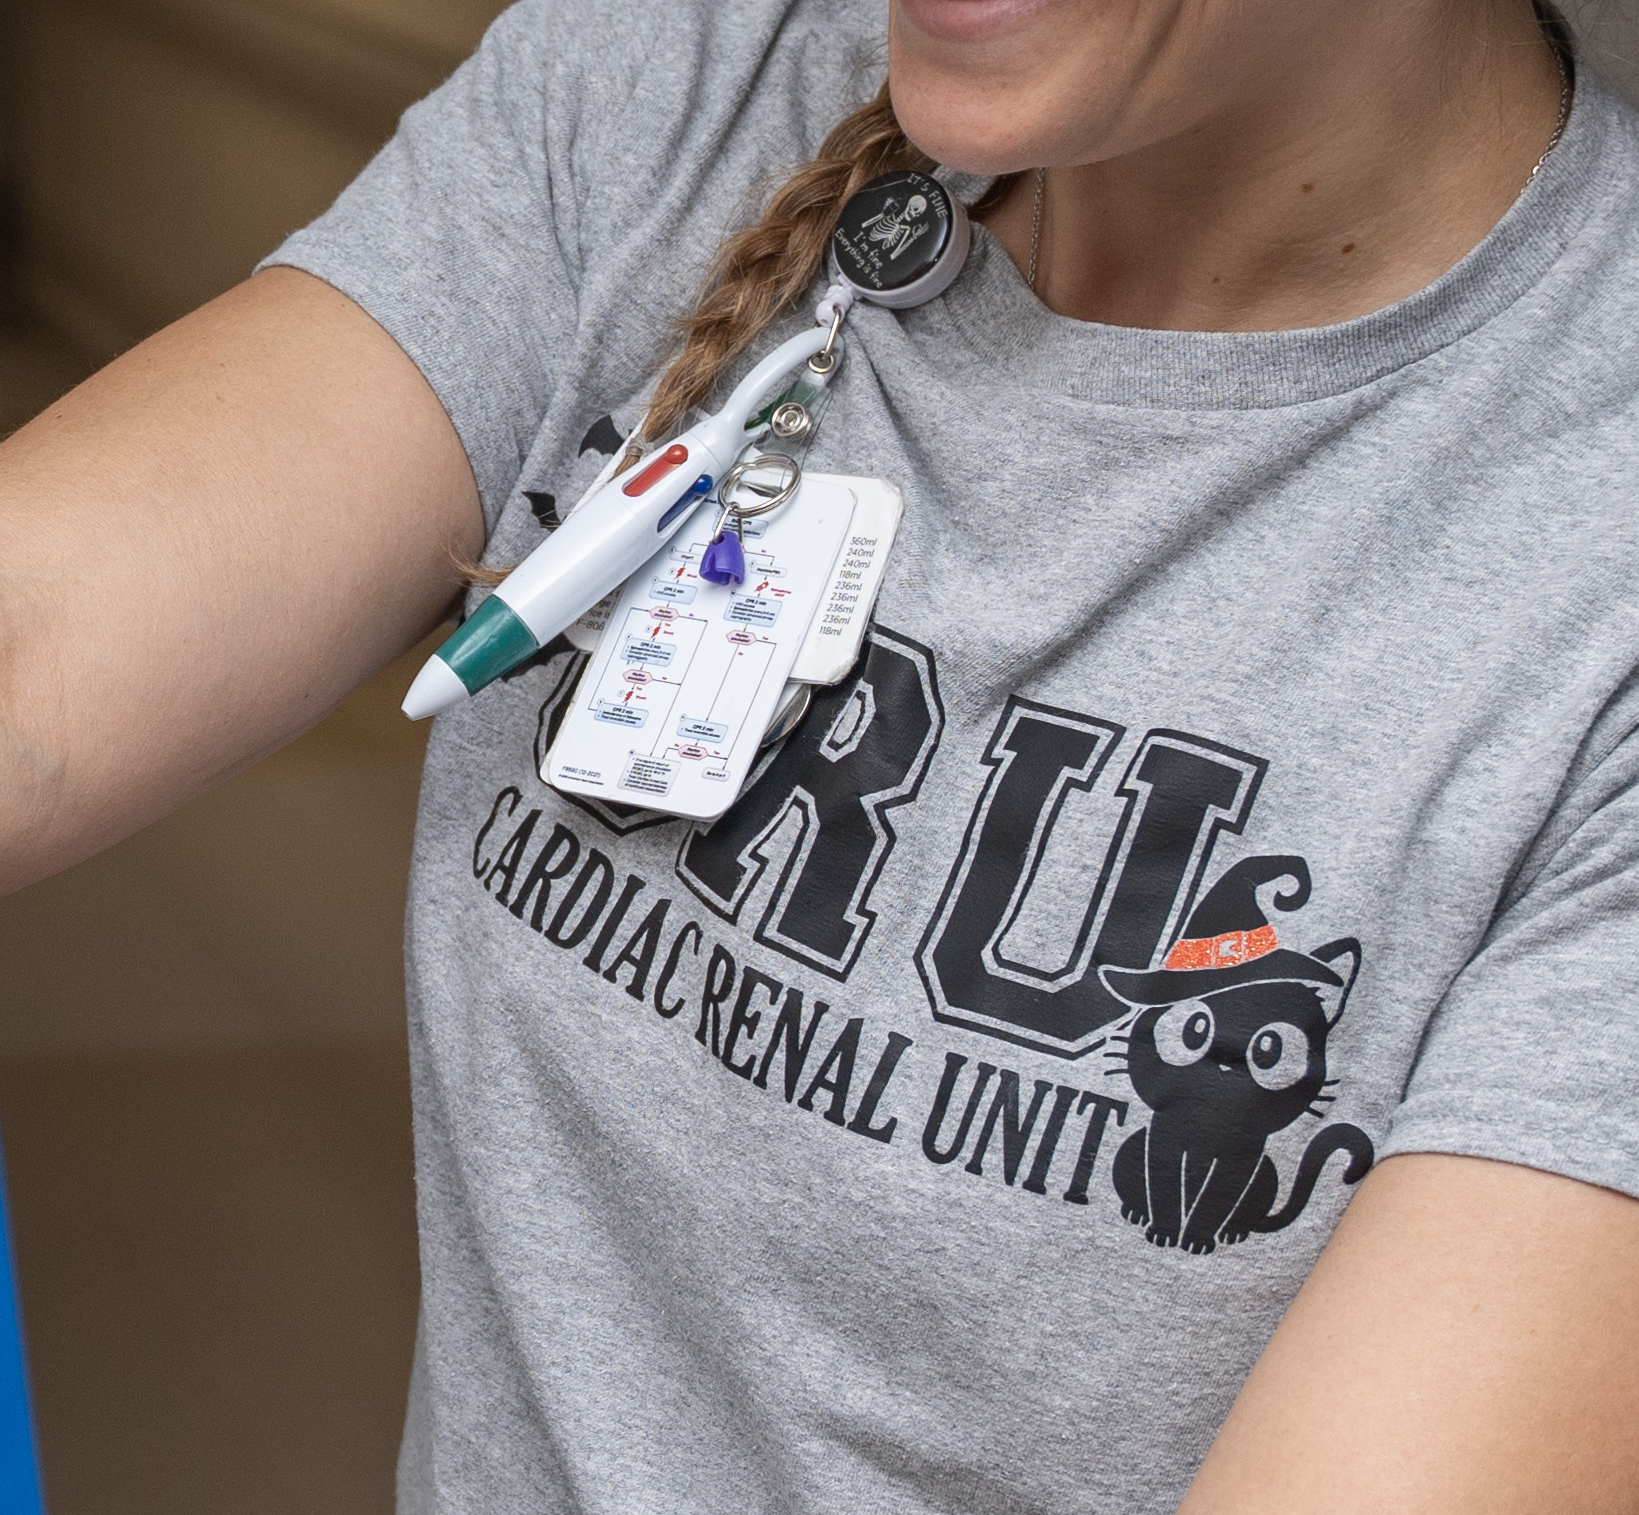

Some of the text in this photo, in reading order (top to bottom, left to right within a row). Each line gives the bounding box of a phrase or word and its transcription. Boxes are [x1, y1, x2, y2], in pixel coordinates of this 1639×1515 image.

[835, 227, 883, 289] Everything is fine
[868, 248, 883, 269] fine
[850, 536, 878, 546] 360ml
[846, 548, 875, 557] 240ml
[842, 559, 871, 568] 240ml
[839, 570, 862, 579] 118ml
[834, 581, 863, 591] 236ml
[830, 592, 859, 602] 236ml
[826, 603, 855, 614] 236ml
[822, 614, 851, 624] 236ml
[818, 626, 843, 636] 118ml
[536, 622, 1270, 1060] RU
[472, 786, 1130, 1205] CARDIAC RENAL UNIT
